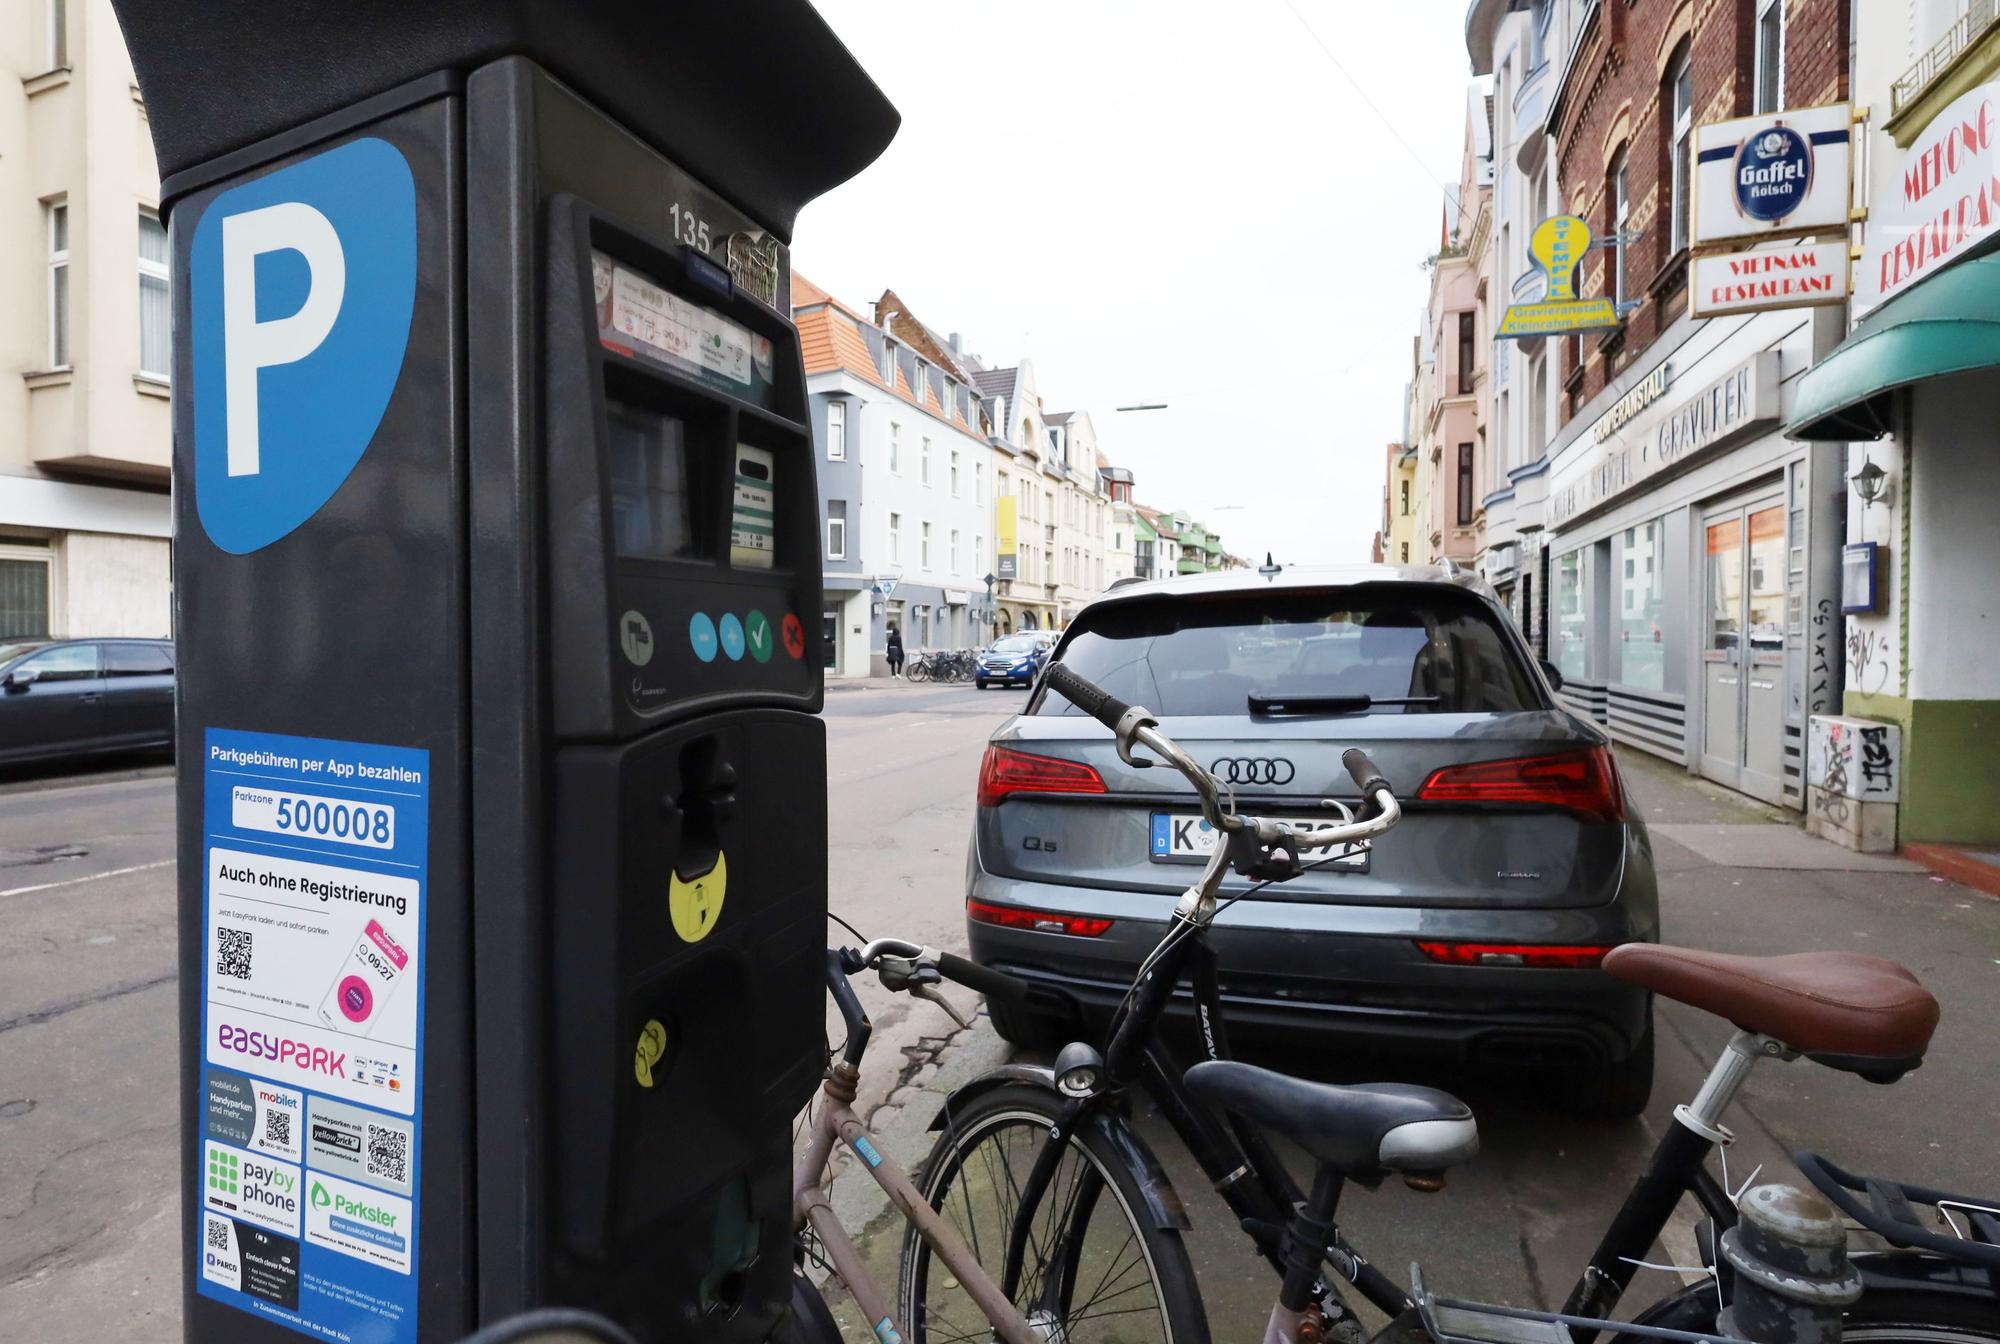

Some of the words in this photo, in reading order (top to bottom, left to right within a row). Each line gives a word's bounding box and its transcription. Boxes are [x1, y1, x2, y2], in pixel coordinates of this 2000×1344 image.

[1903, 99, 1995, 211] MEKONG
[1740, 159, 1805, 185] Gaffel
[1751, 181, 1792, 198] Kölsch
[669, 202, 710, 255] 135
[1729, 252, 1816, 276] VIETNAM
[1711, 274, 1833, 304] RESTAURANT
[1513, 302, 1606, 318] Gravieranstalt
[222, 202, 346, 477] P
[1593, 361, 1671, 445] GRAVIERANSTALT
[1658, 367, 1750, 462] GRAVUREN
[211, 746, 298, 769] Parkgebühren
[302, 758, 324, 773] per
[327, 759, 354, 777] App
[358, 762, 421, 783] bezahlen
[235, 790, 273, 805] Parkzone
[276, 797, 390, 844] 500008
[1158, 838, 1165, 848] D
[1174, 820, 1194, 850] K
[219, 864, 255, 884] Auch
[259, 871, 296, 891] ohne
[300, 878, 407, 915] Registrierung
[368, 953, 394, 981] 09:27
[1200, 1003, 1217, 1061] BATAV
[210, 1092, 252, 1112] Handyparken
[210, 1105, 222, 1114] und
[260, 1091, 297, 1108] mobilet
[312, 1113, 351, 1129] Handyparken
[352, 1124, 362, 1132] mit
[243, 1183, 295, 1212] phone
[335, 1194, 397, 1227] Parkster
[217, 1258, 237, 1272] PARCO
[259, 1303, 302, 1325] Zusammenarbeit
[303, 1320, 312, 1328] mit
[312, 1322, 322, 1332] der
[322, 1326, 337, 1338] Stadt
